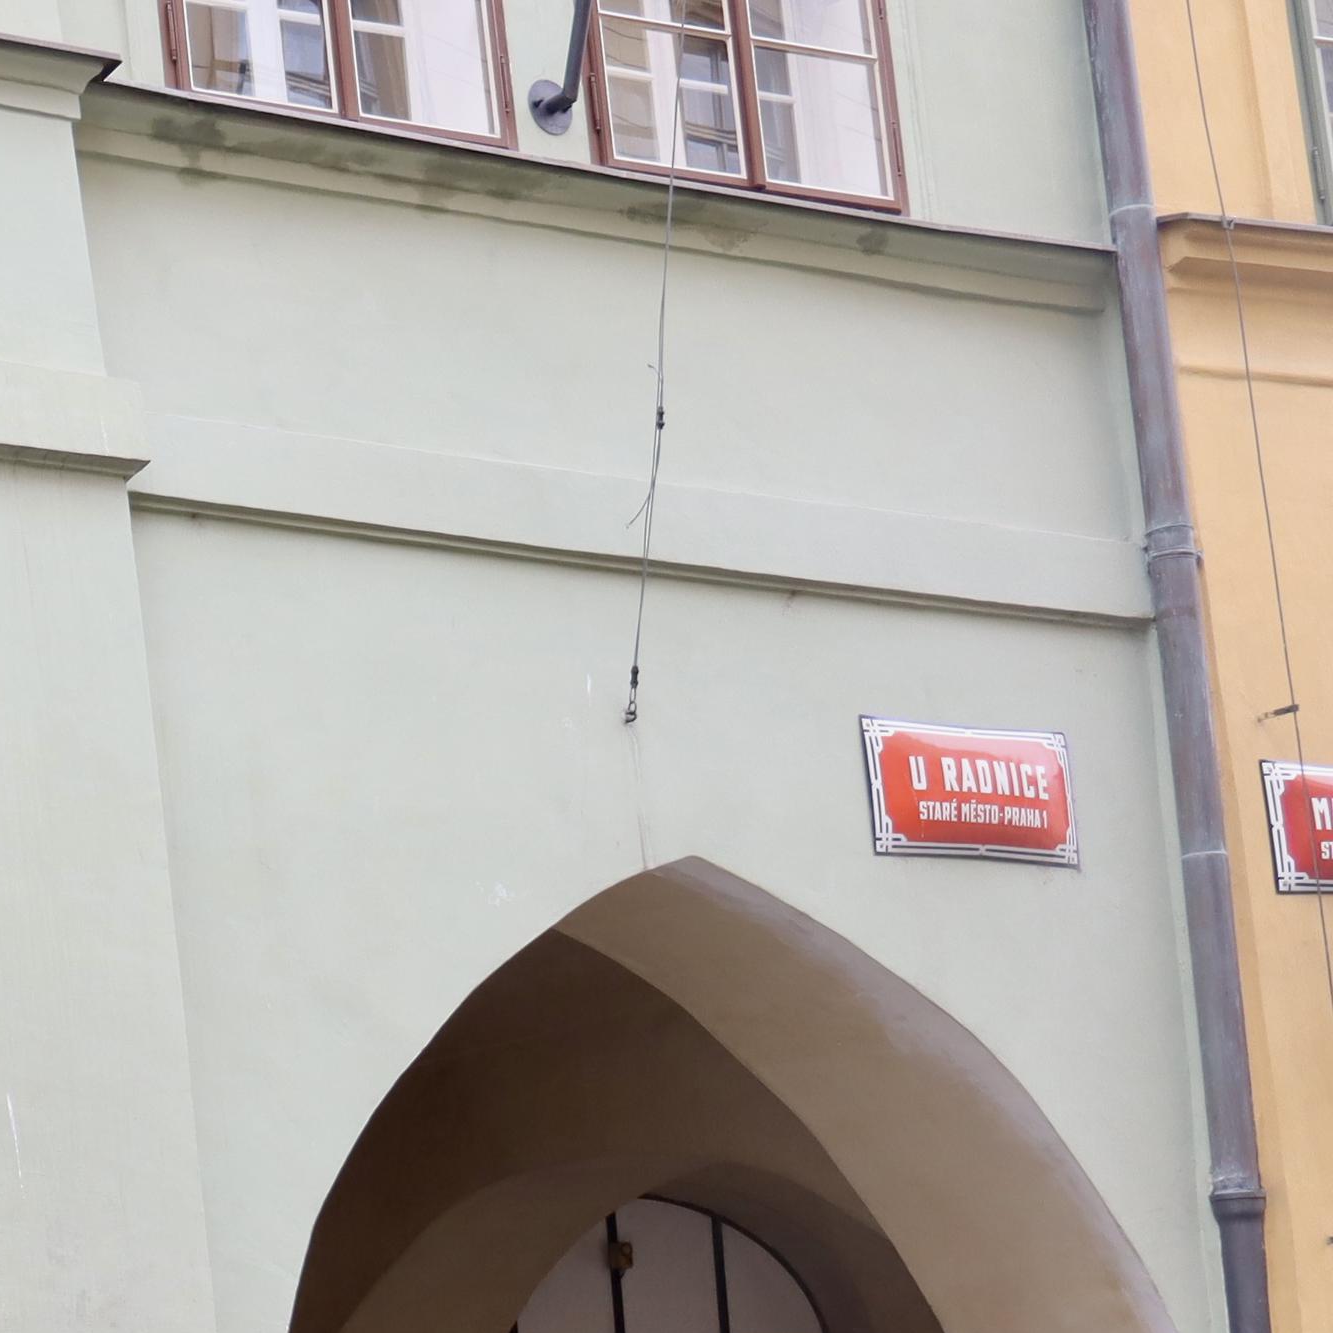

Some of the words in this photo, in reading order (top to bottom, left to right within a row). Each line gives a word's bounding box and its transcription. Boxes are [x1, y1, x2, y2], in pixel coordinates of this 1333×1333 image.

[908, 755, 928, 791] U
[940, 756, 1050, 800] RADNICE
[919, 799, 958, 822] STARÉ
[961, 800, 1041, 829] MĚSTO-PRAHA
[1042, 810, 1049, 829] 1
[1311, 797, 1333, 830] M
